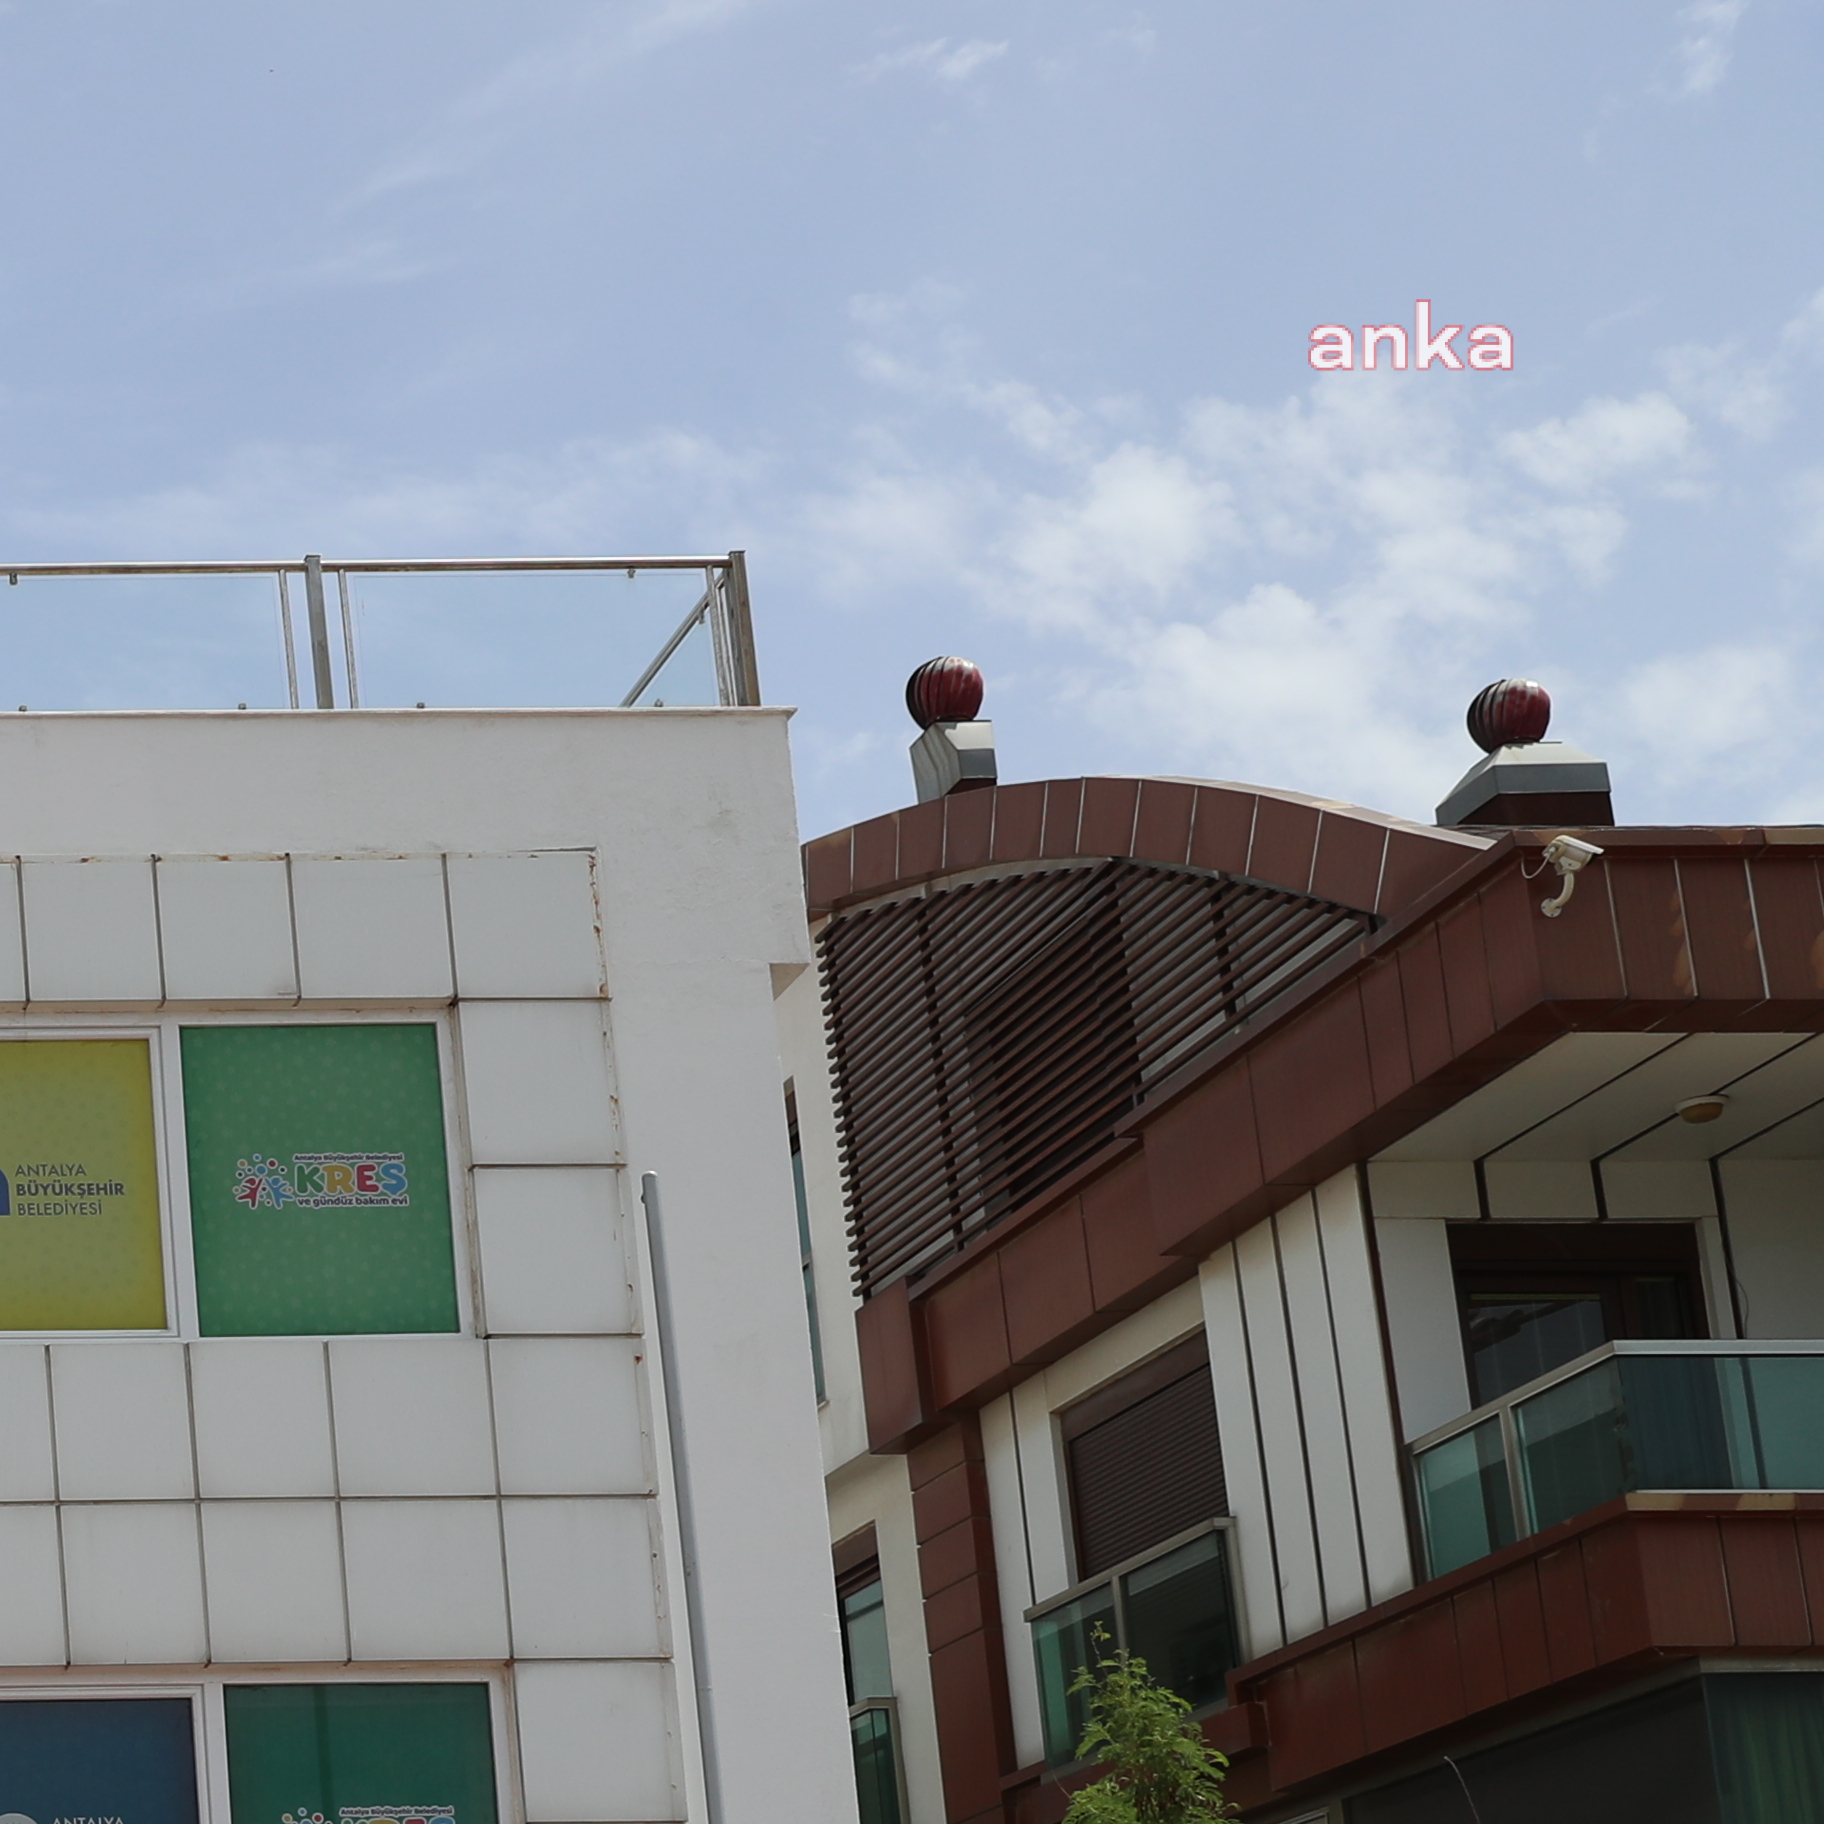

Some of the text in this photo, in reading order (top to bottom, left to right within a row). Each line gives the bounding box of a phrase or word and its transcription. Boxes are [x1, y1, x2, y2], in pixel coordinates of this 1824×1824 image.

[15, 1164, 87, 1177] ANTALYA
[295, 1163, 406, 1194] KREŞ
[16, 1179, 124, 1199] BÜYÜKŞEHİR
[18, 1199, 102, 1215] BELEDİYESİ
[313, 1196, 352, 1207] gündüz
[356, 1196, 389, 1205] bakım
[392, 1196, 407, 1205] evi
